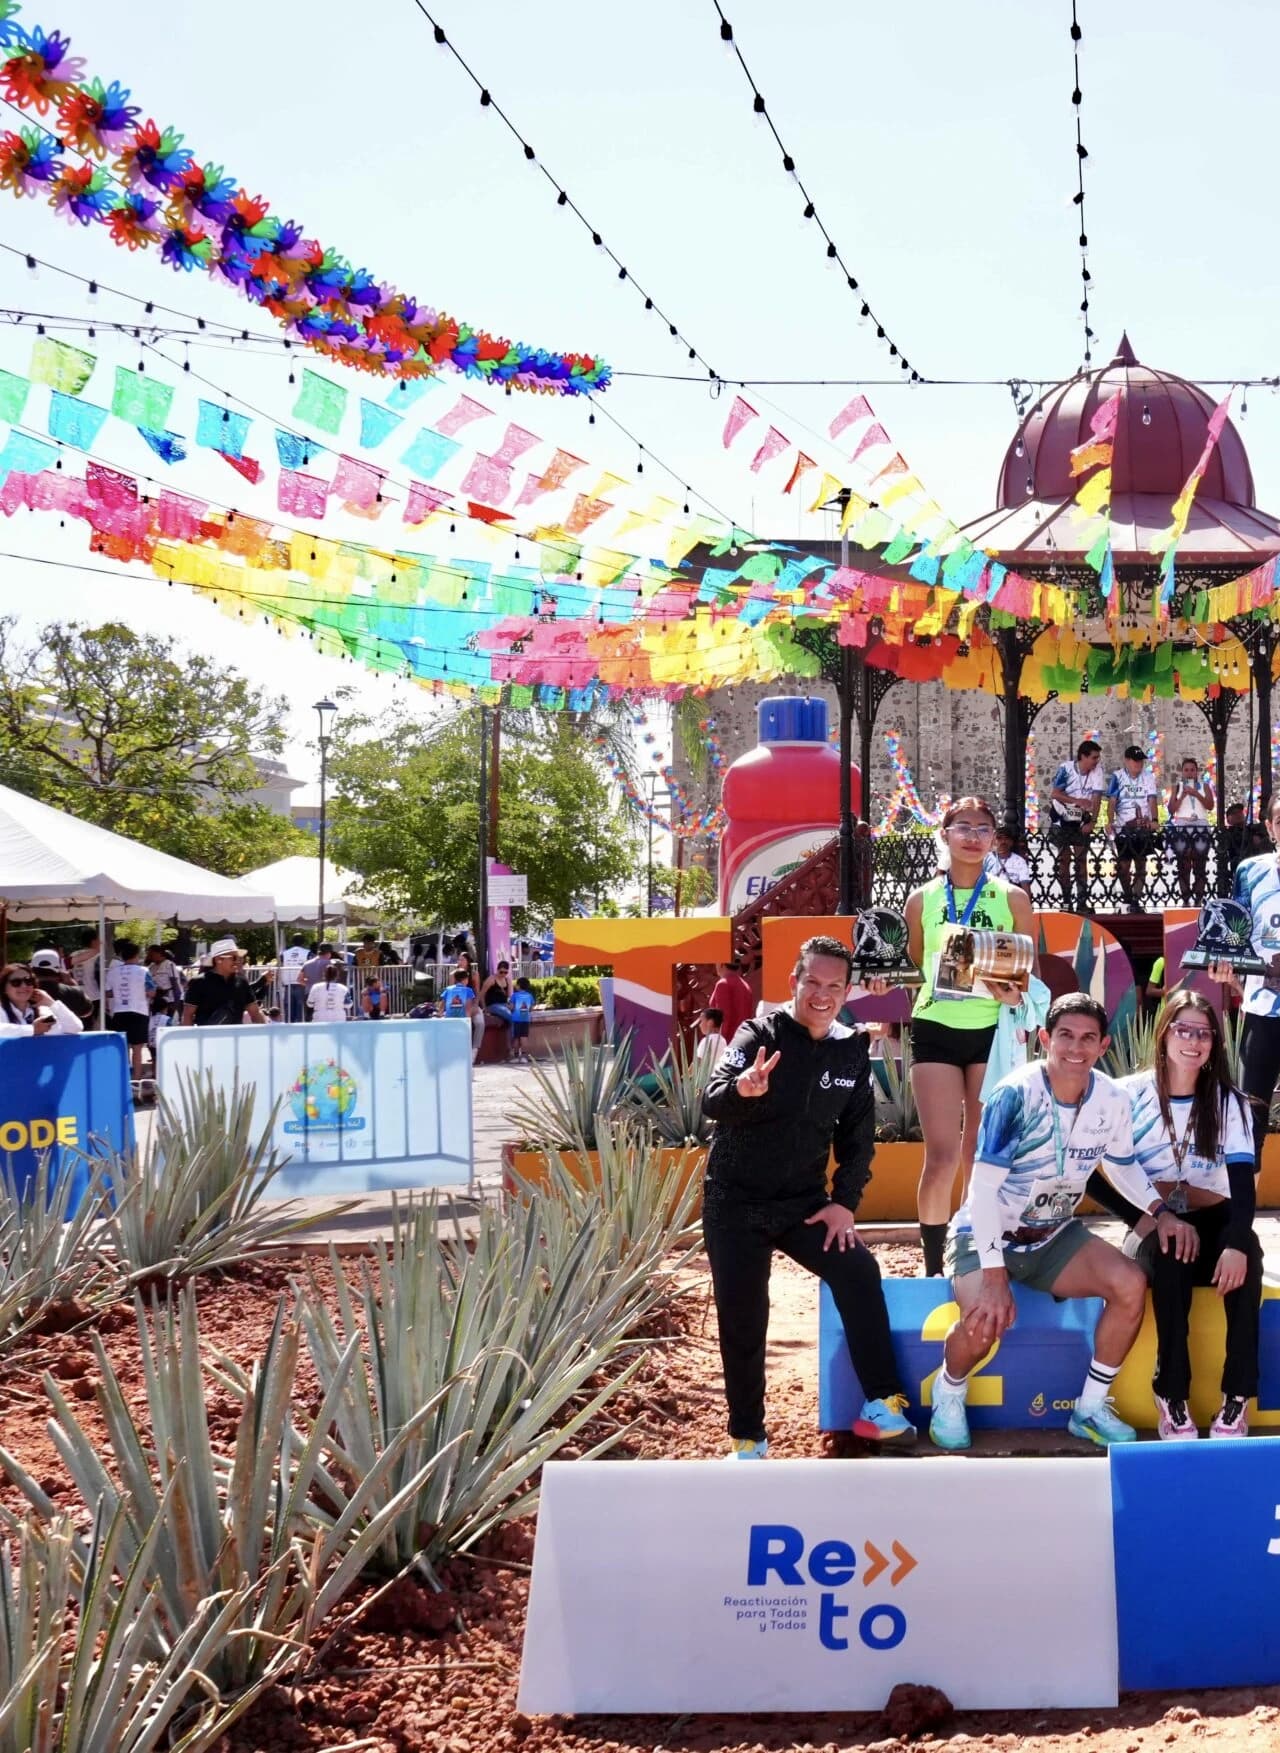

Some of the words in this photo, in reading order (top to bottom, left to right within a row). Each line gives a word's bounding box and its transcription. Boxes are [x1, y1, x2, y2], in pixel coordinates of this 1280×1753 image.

[746, 876, 779, 896] Ele
[0, 1116, 79, 1151] ODE
[921, 1301, 1003, 1406] 2
[1052, 1399, 1078, 1410] CO
[724, 1596, 808, 1607] Reactivación
[736, 1608, 766, 1621] para
[771, 1608, 807, 1619] Todas
[759, 1622, 767, 1633] y
[771, 1619, 807, 1631] Todos
